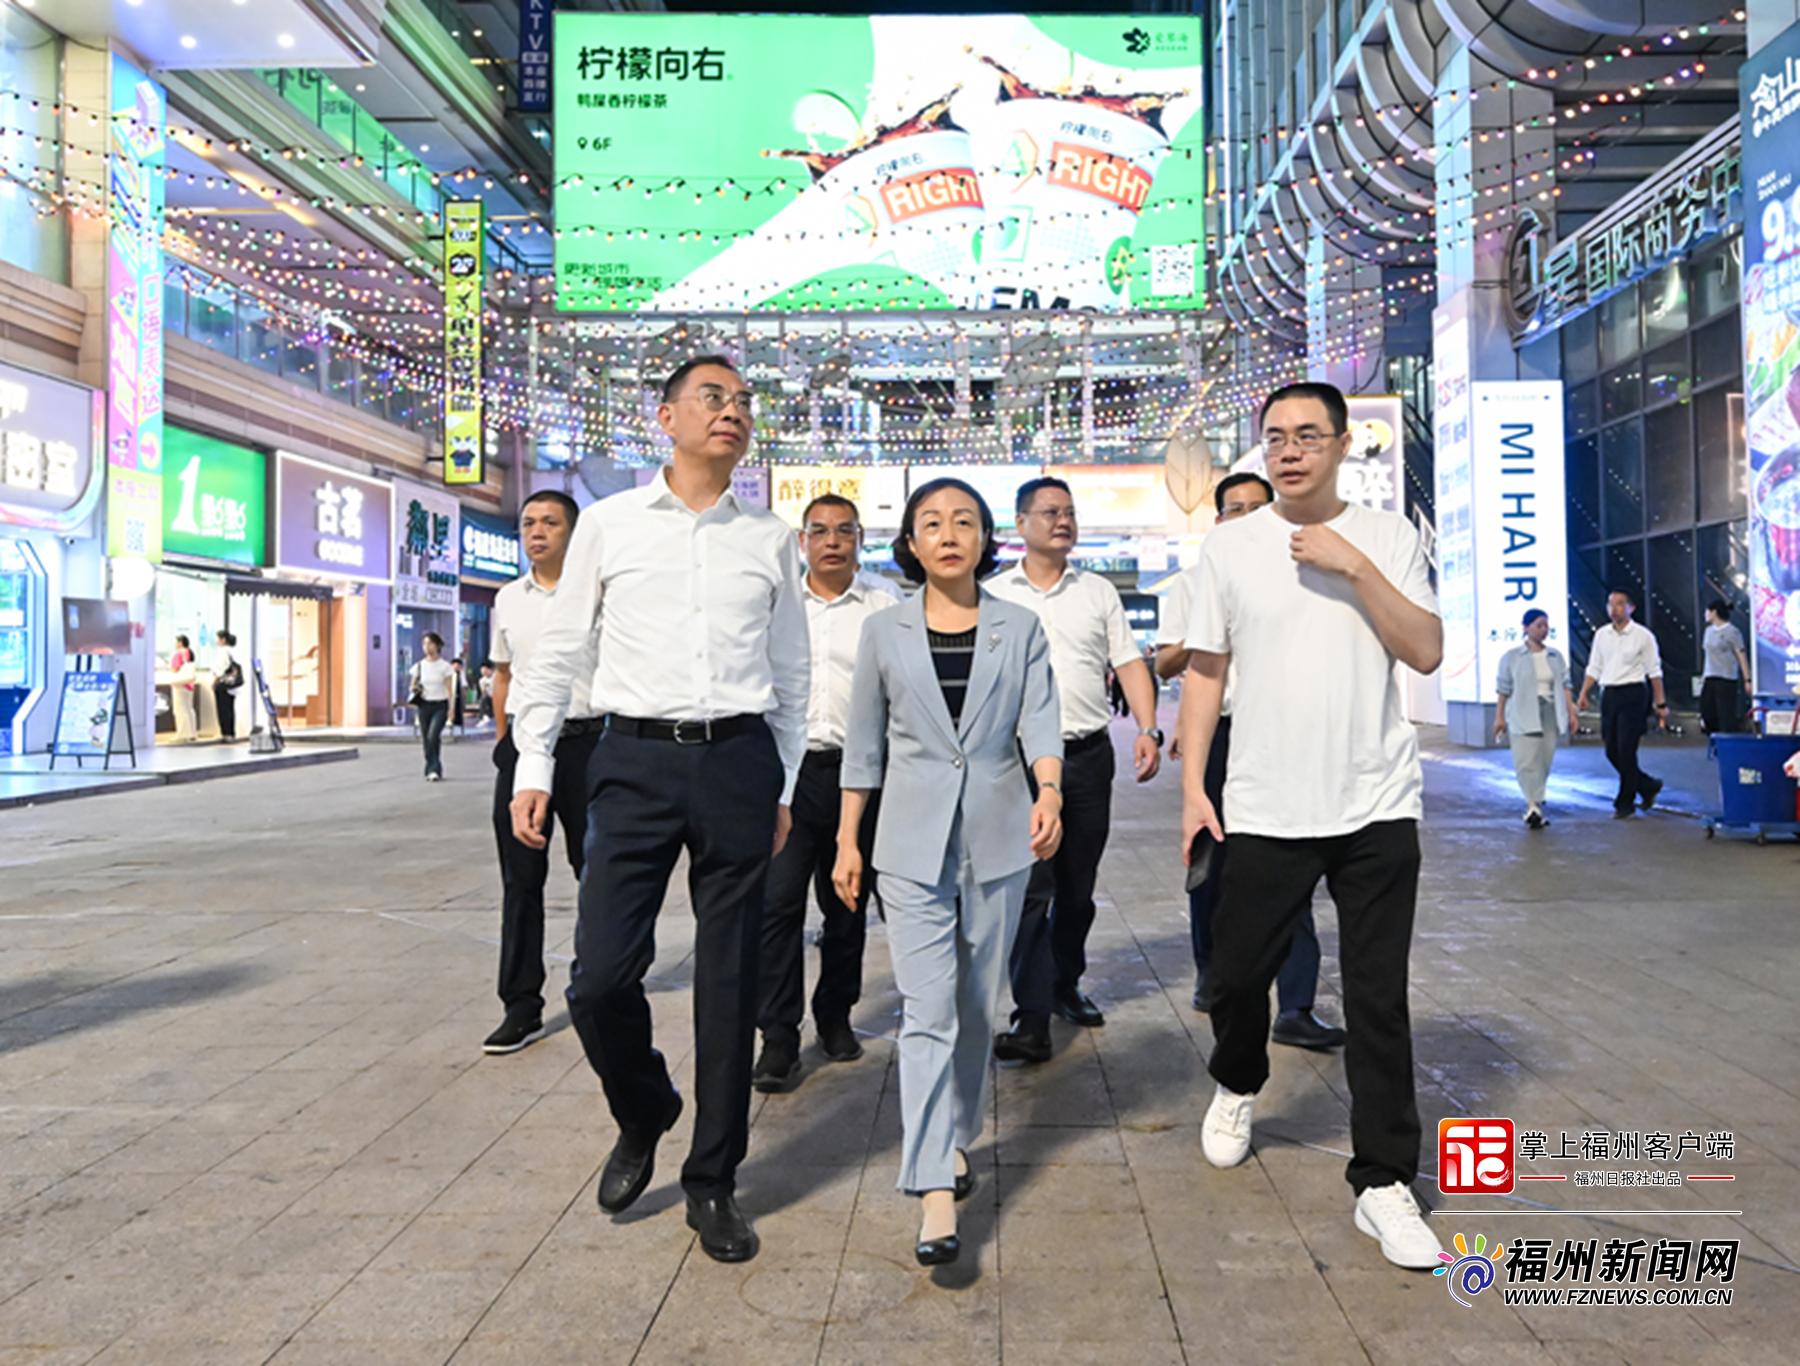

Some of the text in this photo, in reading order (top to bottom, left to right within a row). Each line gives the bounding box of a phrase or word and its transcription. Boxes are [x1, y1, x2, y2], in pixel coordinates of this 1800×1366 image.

[577, 46, 726, 81] 柠檬向右
[592, 137, 612, 151] 6F
[885, 174, 978, 217] RIGHT
[1052, 150, 1151, 206] RIGHT
[1500, 423, 1535, 475] MI
[1501, 493, 1538, 602] HAIR
